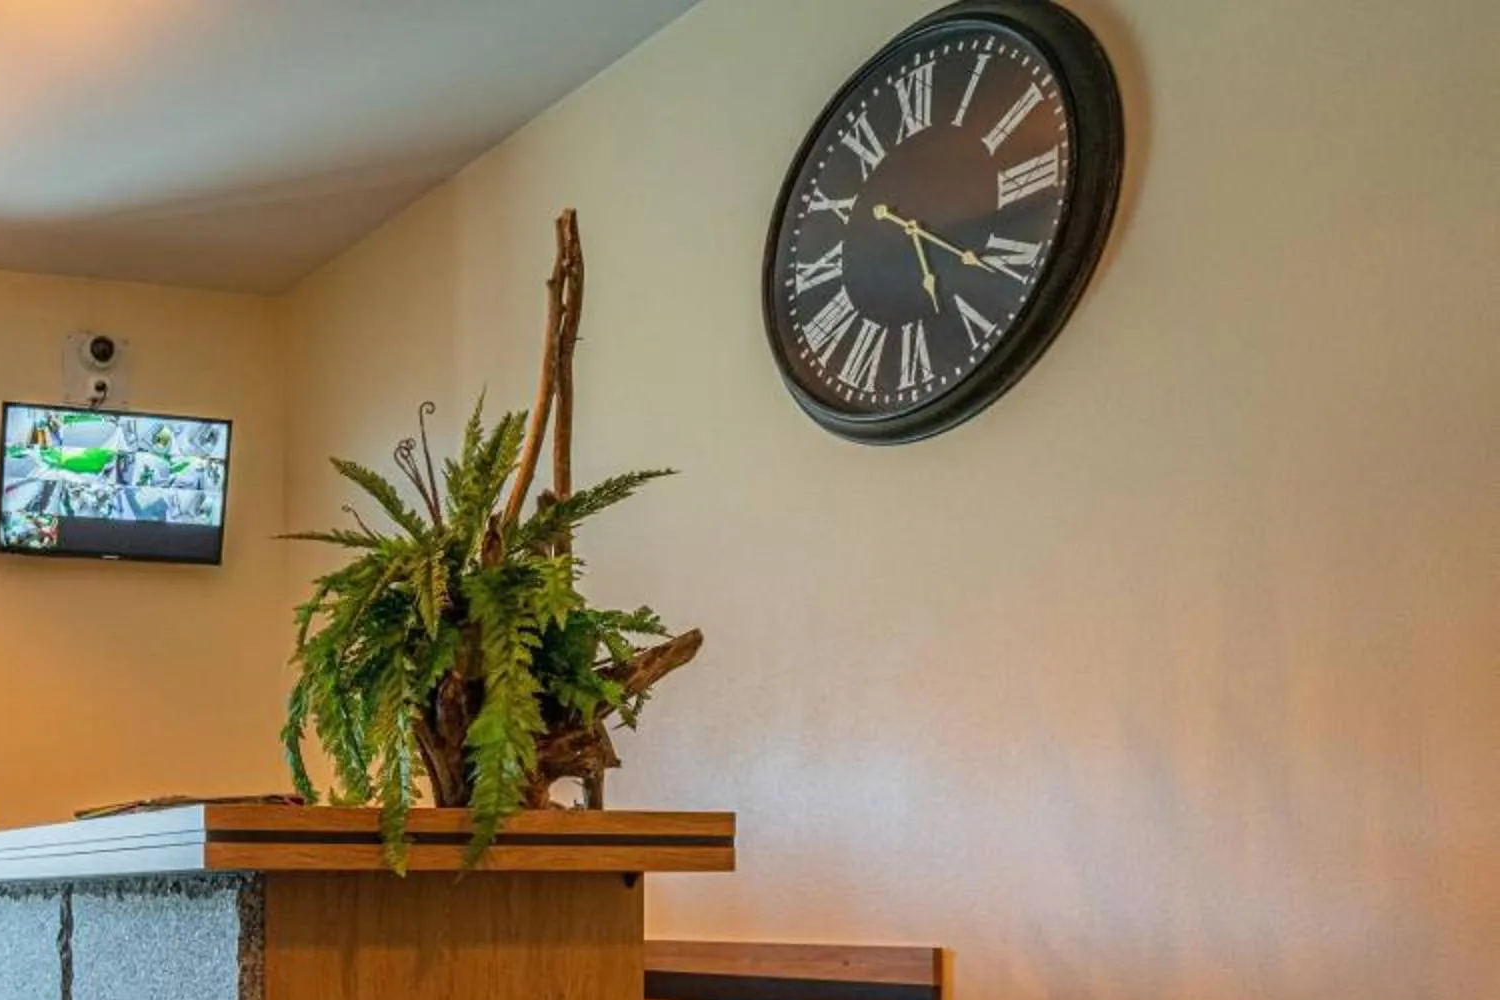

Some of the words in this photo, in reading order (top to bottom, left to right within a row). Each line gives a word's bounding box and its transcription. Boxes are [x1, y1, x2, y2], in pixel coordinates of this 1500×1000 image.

[894, 60, 935, 145] XII
[953, 53, 990, 127] I
[981, 82, 1044, 155] II
[842, 111, 887, 181] XI
[998, 145, 1059, 209] III
[807, 189, 858, 224] X
[796, 241, 843, 294] IX
[802, 285, 859, 368] VIII
[838, 319, 888, 392] VII
[897, 319, 935, 390] VI
[954, 294, 998, 350] V
